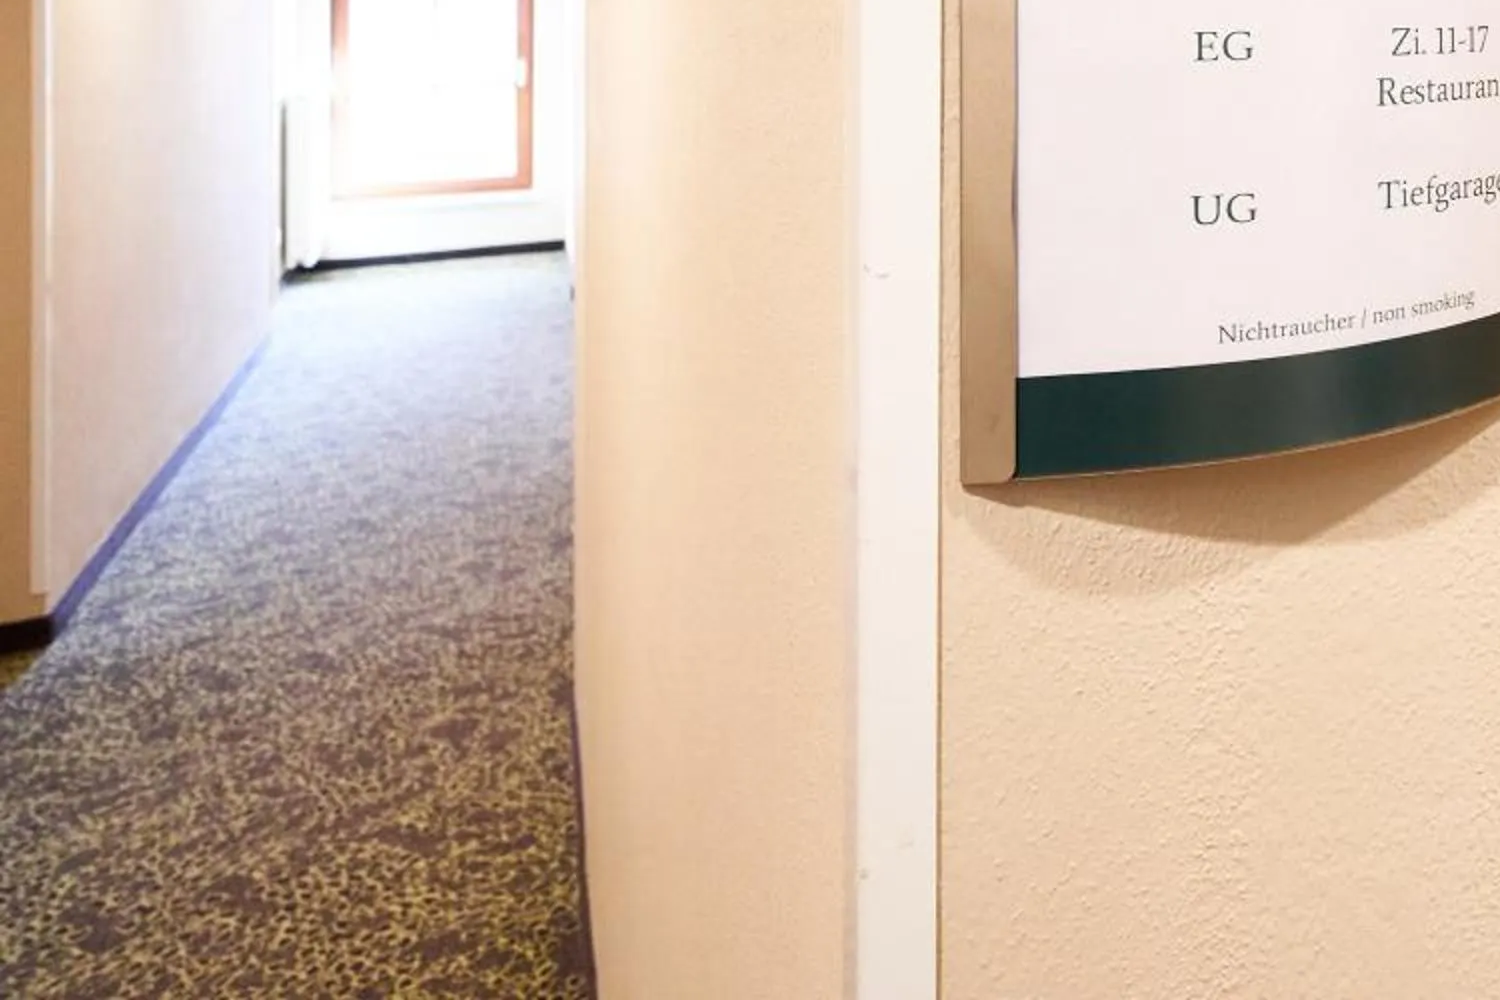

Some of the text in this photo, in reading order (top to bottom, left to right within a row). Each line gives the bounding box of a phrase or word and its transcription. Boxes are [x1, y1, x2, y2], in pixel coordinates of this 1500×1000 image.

[1194, 30, 1254, 62] EG
[1391, 25, 1489, 57] Zi. 11-17
[1192, 192, 1257, 226] UG
[1217, 289, 1476, 345] Nichtraucher / non smoking
